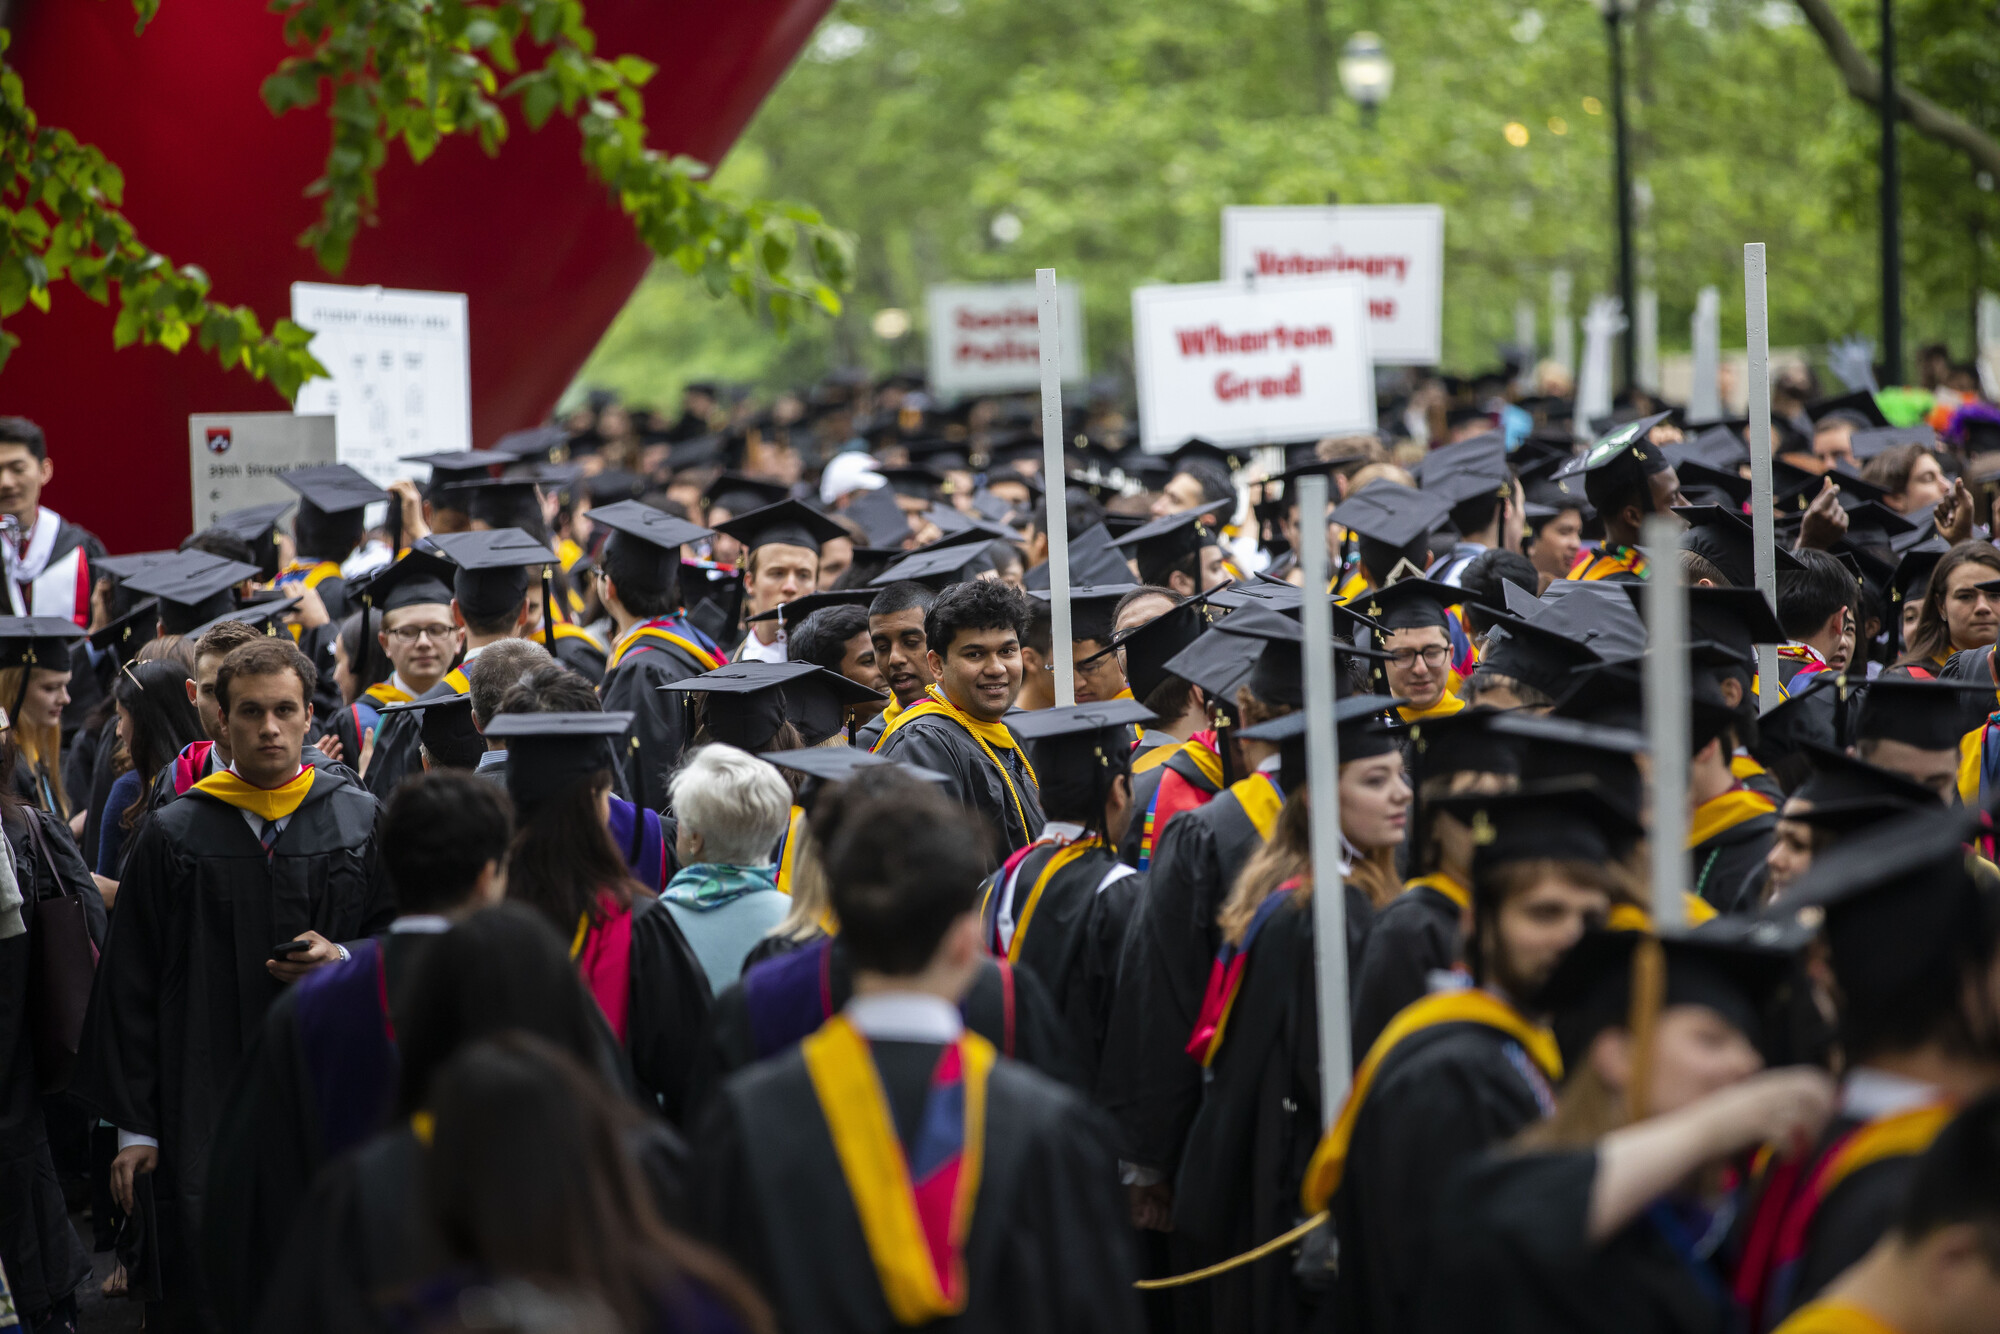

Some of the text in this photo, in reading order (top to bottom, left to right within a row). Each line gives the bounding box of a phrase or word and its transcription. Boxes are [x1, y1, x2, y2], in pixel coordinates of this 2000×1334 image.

[1255, 245, 1407, 284] Veterinary
[1176, 323, 1333, 356] Wharton
[1214, 364, 1302, 401] Grad
